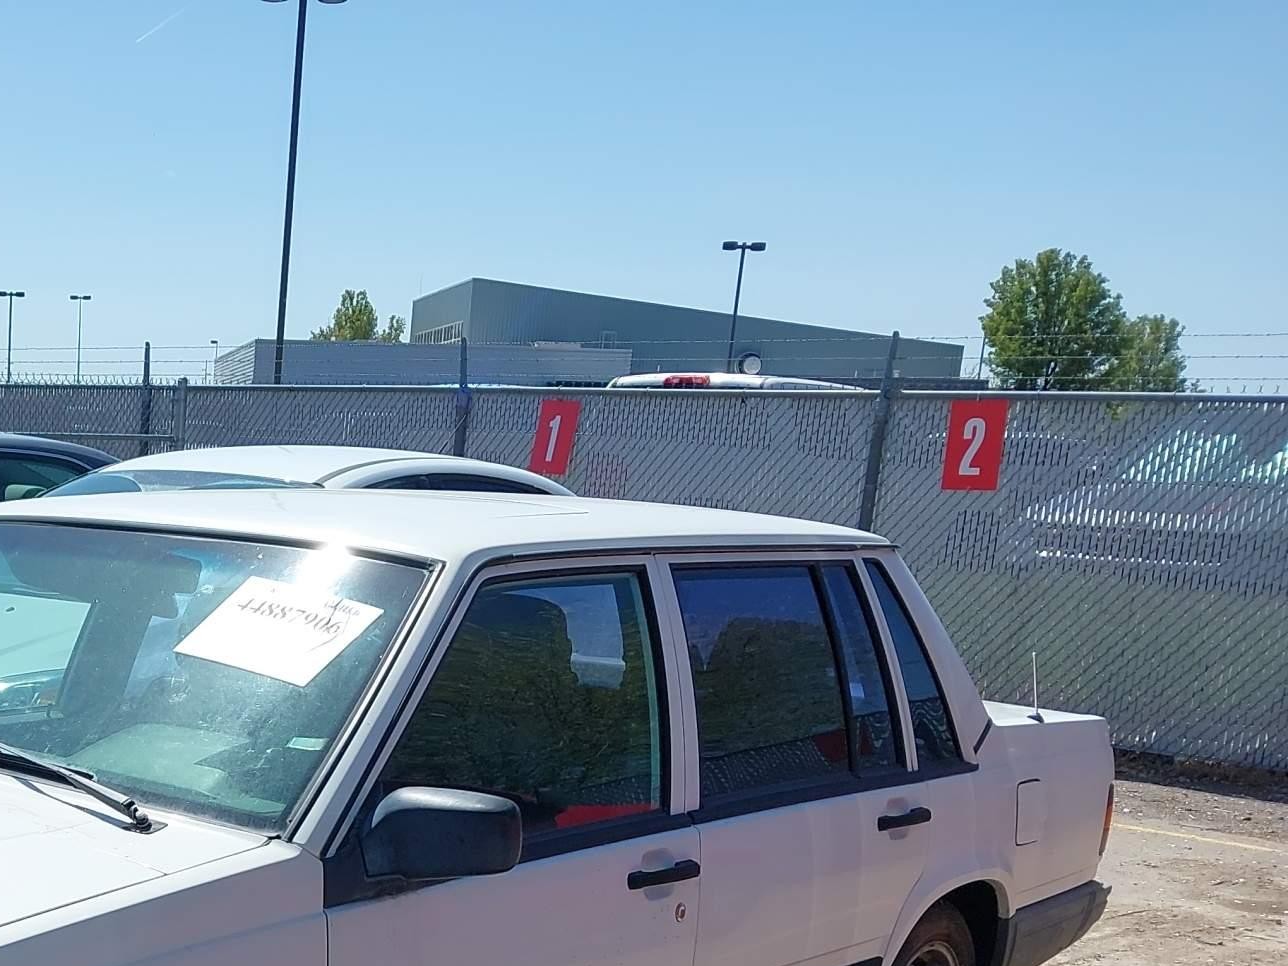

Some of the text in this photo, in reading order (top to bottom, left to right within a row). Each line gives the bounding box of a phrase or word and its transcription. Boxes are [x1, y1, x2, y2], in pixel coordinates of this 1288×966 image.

[545, 415, 562, 462] 1
[958, 417, 986, 476] 2
[237, 598, 344, 635] 44887906
